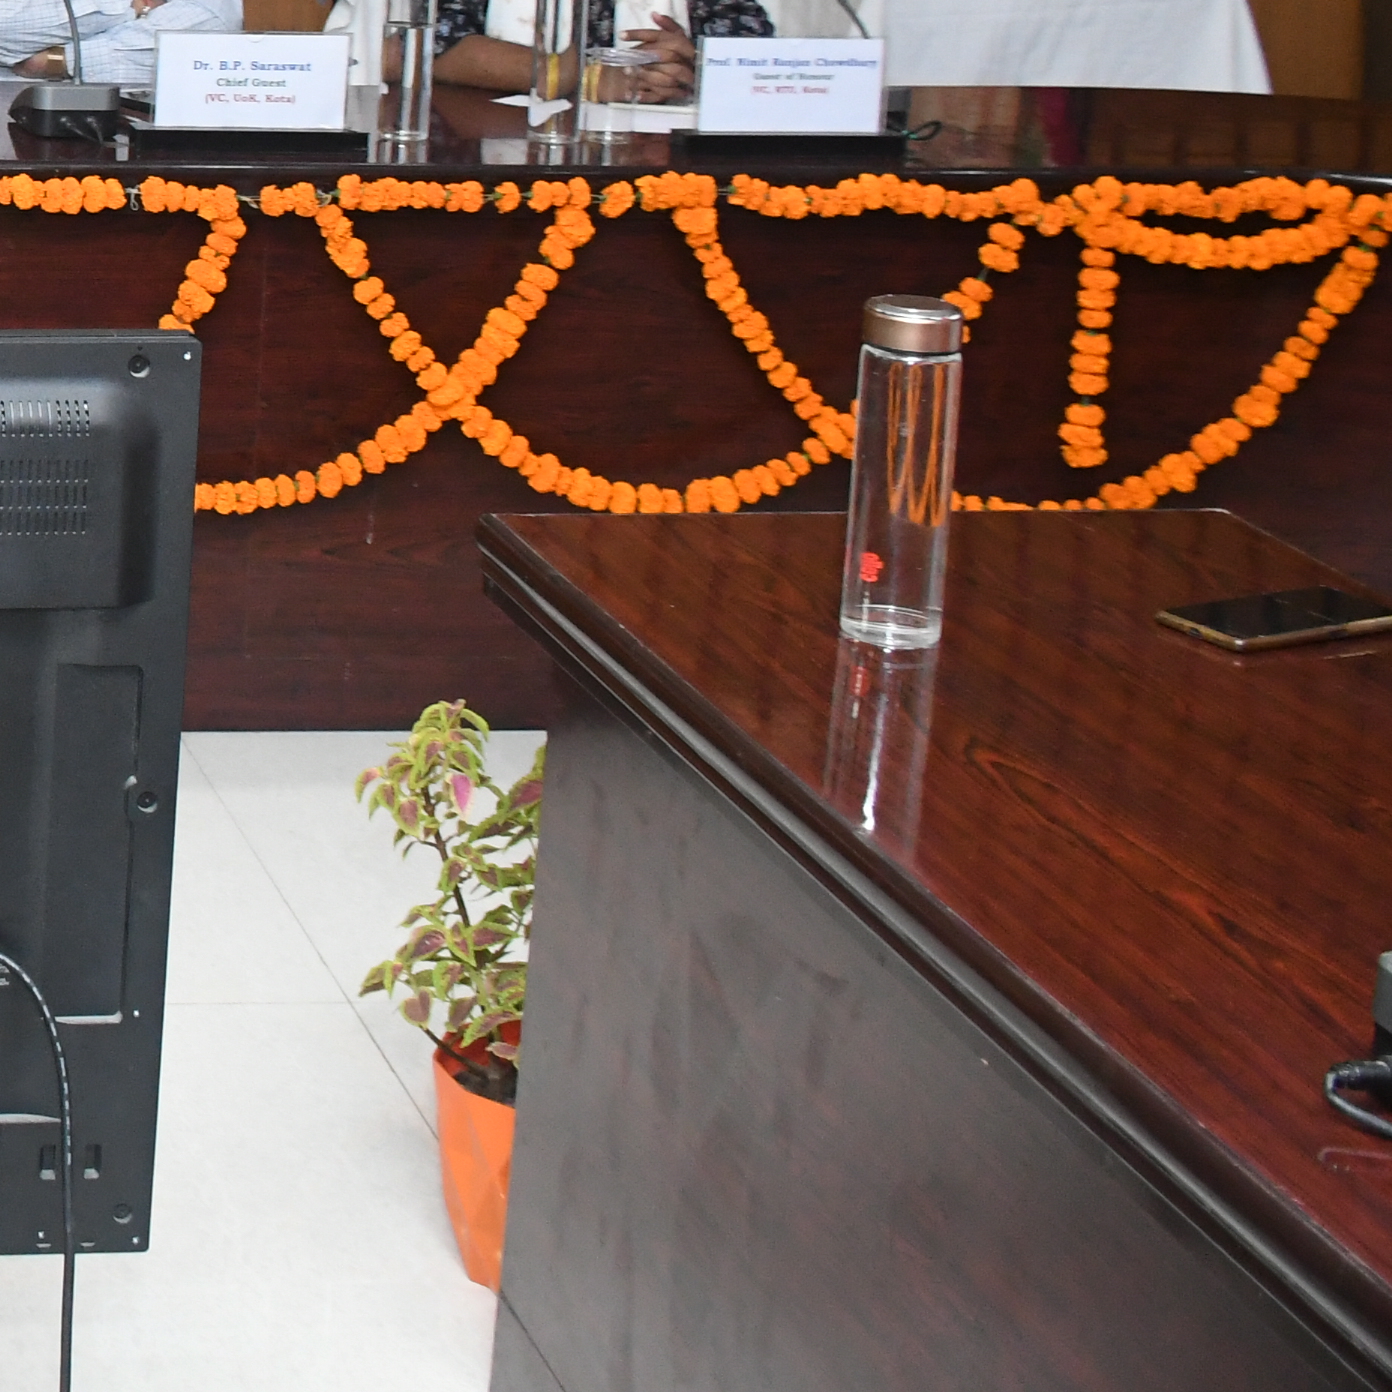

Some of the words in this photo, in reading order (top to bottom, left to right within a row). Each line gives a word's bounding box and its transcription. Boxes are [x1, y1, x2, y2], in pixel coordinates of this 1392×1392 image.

[193, 60, 213, 71] Dr.
[219, 60, 246, 71] B.P.
[250, 61, 312, 71] Saraswat
[216, 77, 249, 87] Chief
[252, 78, 287, 87] Guest
